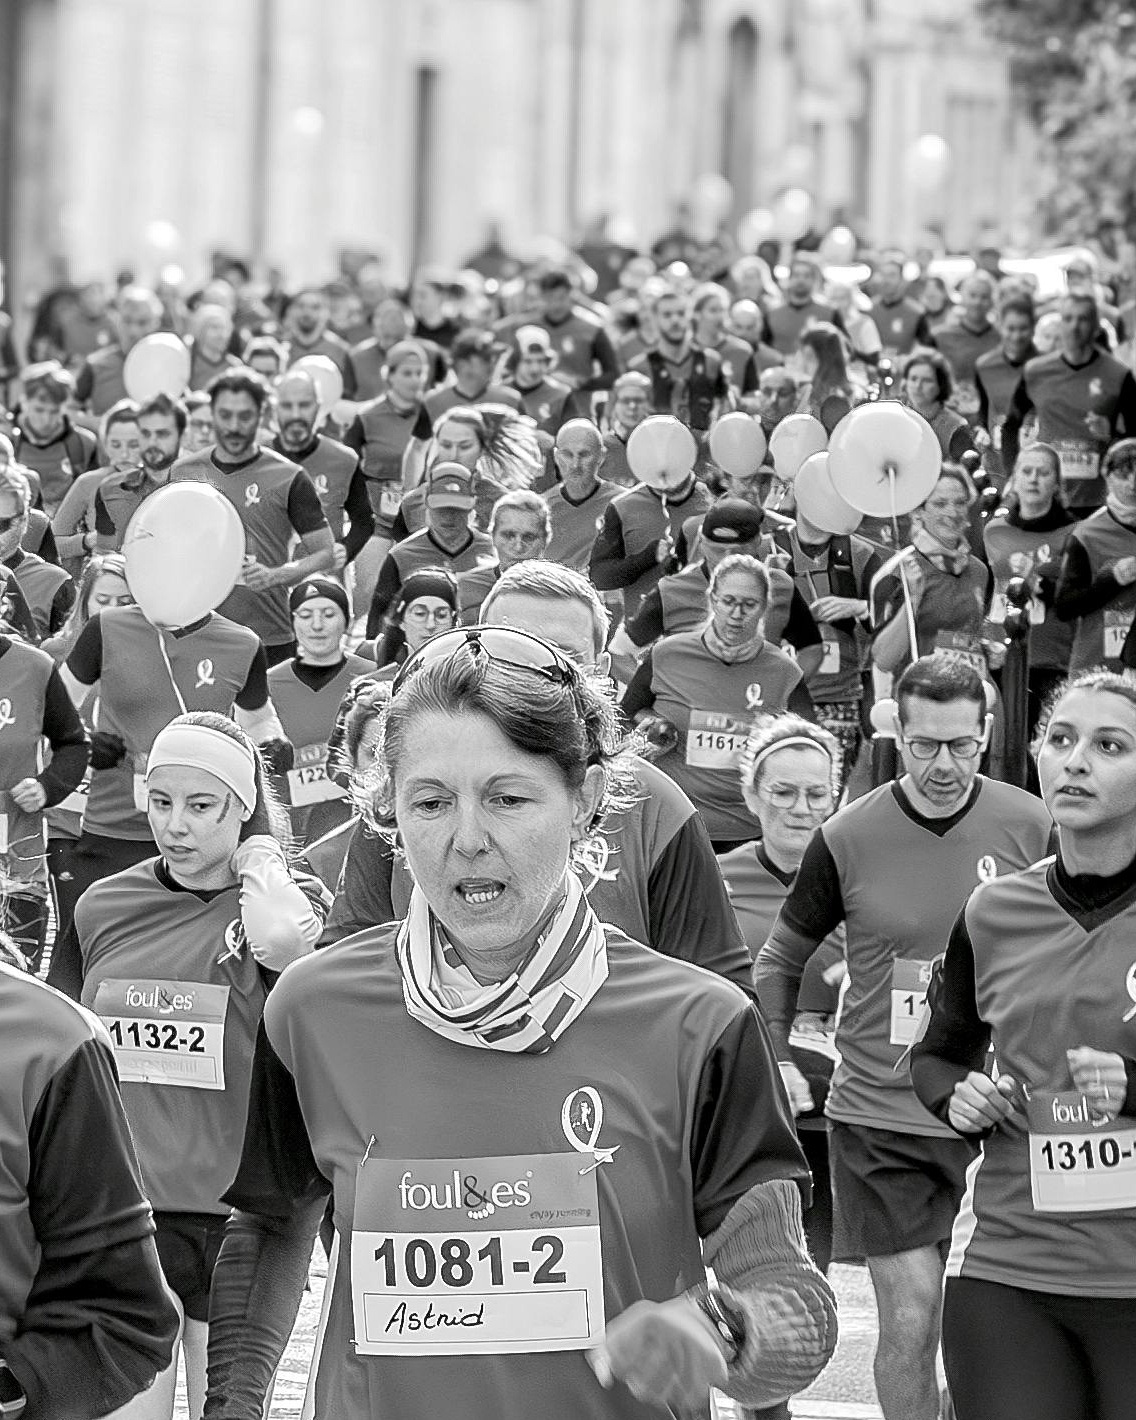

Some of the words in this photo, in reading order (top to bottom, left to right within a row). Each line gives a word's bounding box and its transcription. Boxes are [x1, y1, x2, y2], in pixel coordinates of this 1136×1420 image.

[109, 1020, 205, 1053] 1132-2
[1041, 1138, 1136, 1170] 1310-
[374, 1235, 567, 1288] 1081-2
[384, 1302, 484, 1334] Astrid
